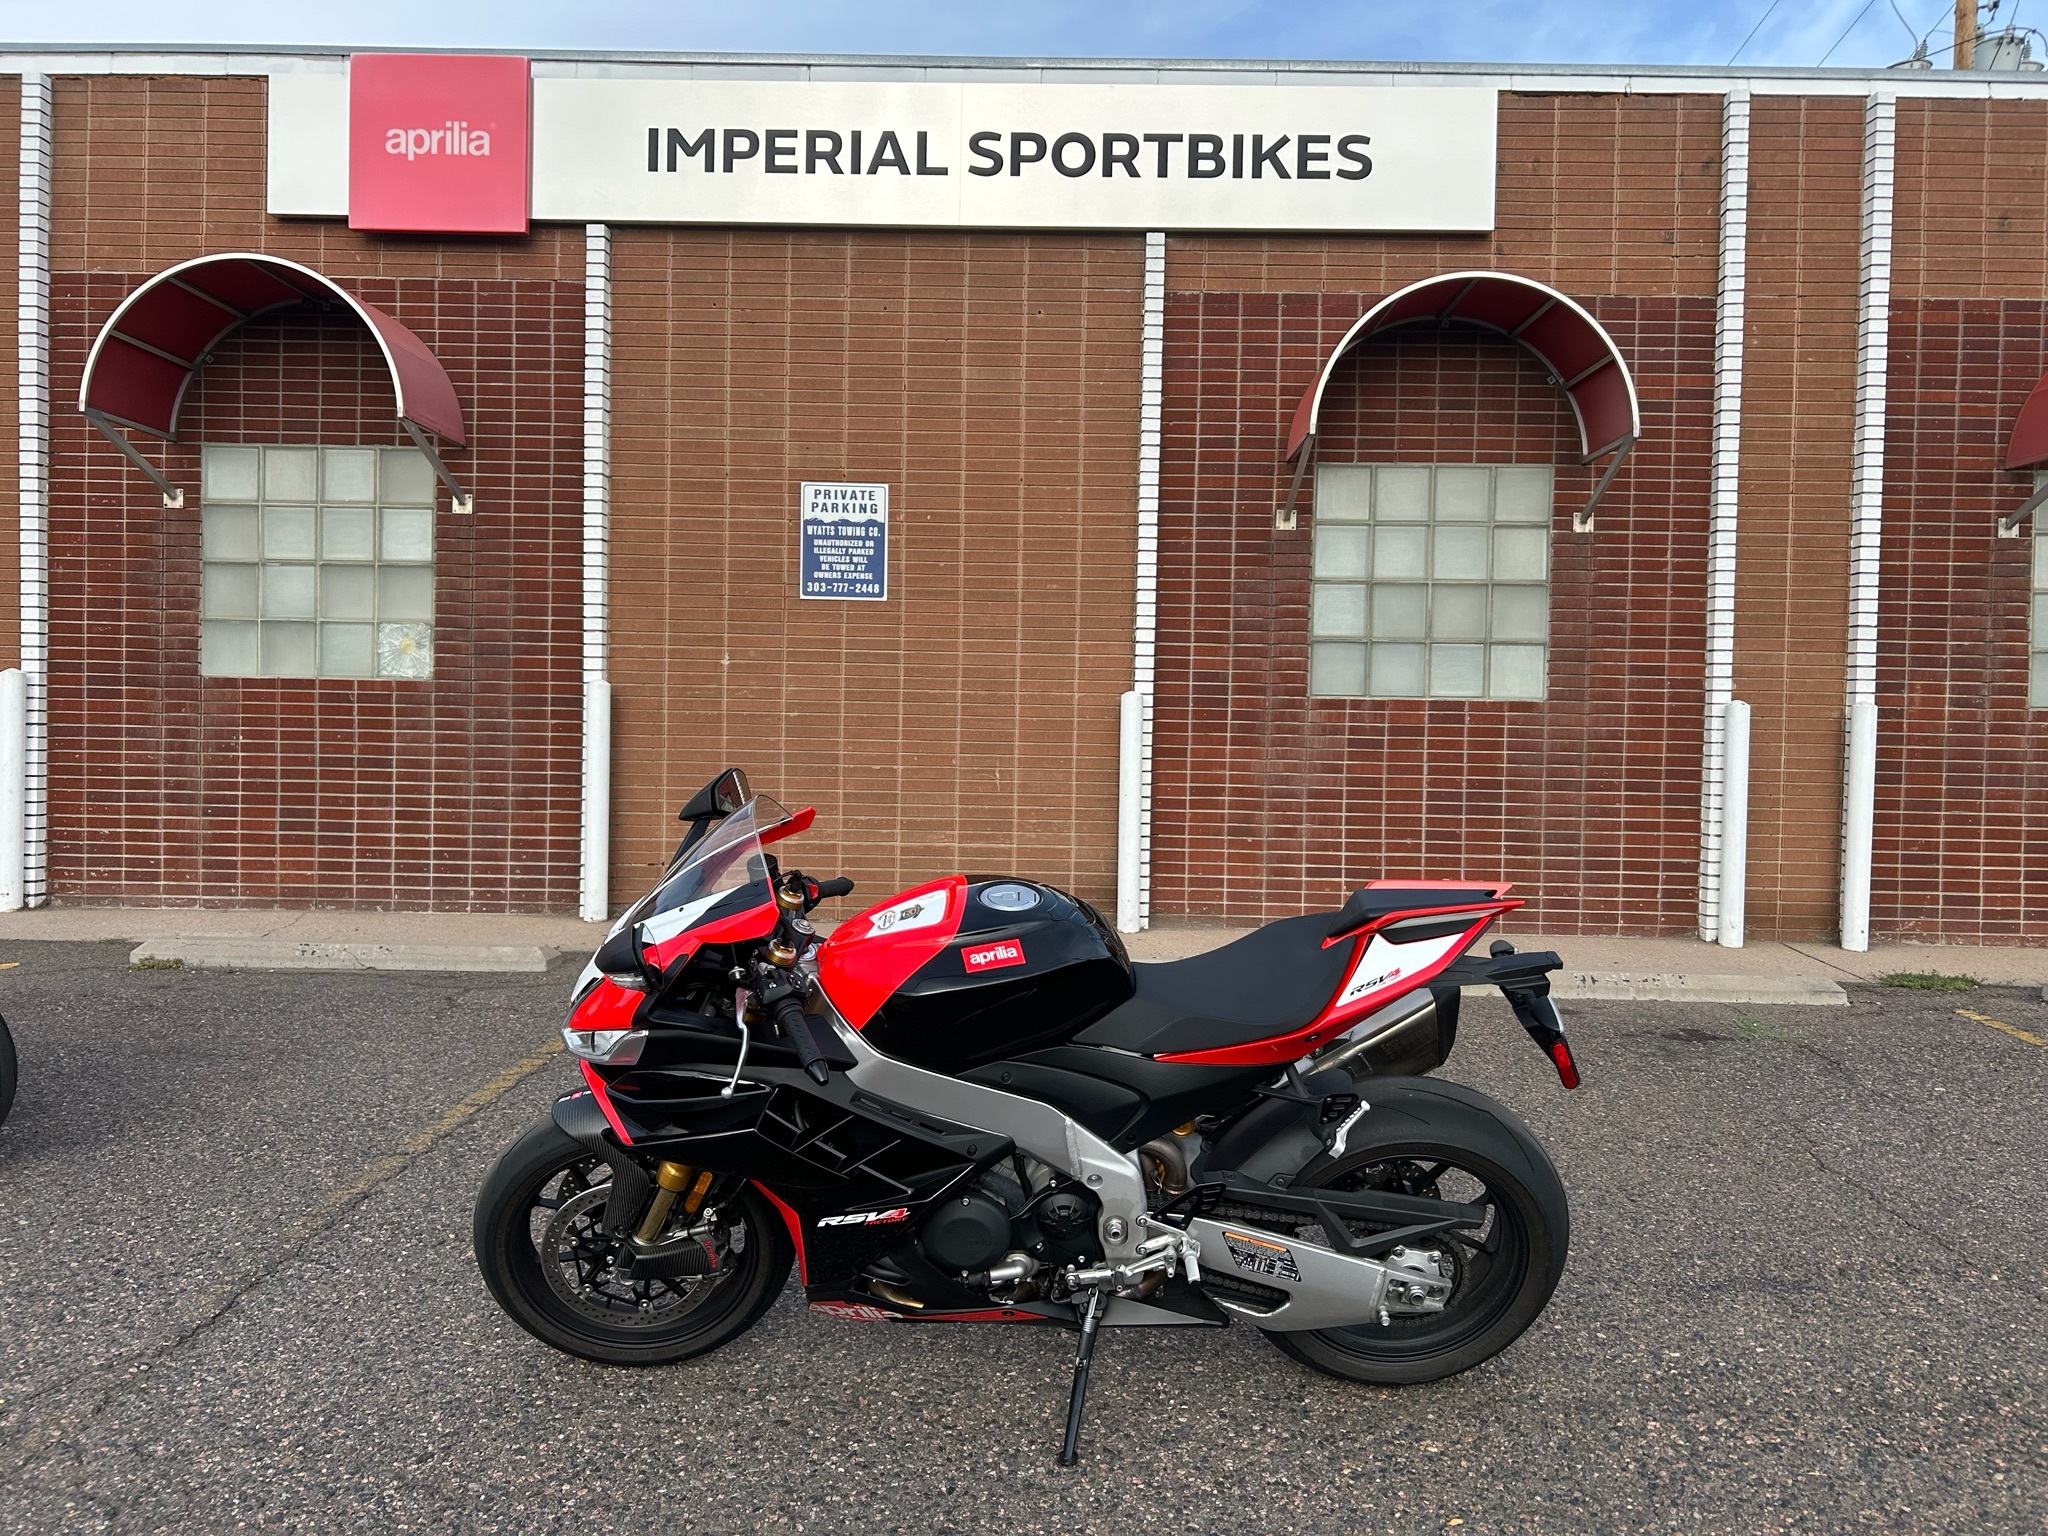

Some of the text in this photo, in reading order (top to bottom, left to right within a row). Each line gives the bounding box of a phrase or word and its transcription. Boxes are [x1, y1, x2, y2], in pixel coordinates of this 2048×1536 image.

[385, 121, 490, 161] aprilia
[647, 127, 1373, 180] IMPERIAL SPORTBIKES
[814, 489, 876, 501] PRIVATE
[811, 502, 878, 514] PARKING
[807, 525, 881, 537] WYATTS TOWING CO.
[813, 539, 862, 547] UNAUTHORIZED
[813, 547, 846, 555] ILLEGALLY
[819, 555, 850, 563] VEHICLES
[813, 571, 873, 580] OWNERS EXPENSE
[807, 582, 880, 593] 303-777-2448
[970, 945, 1018, 965] aprilia
[1350, 967, 1402, 996] RSV4
[817, 1208, 911, 1227] RSV4
